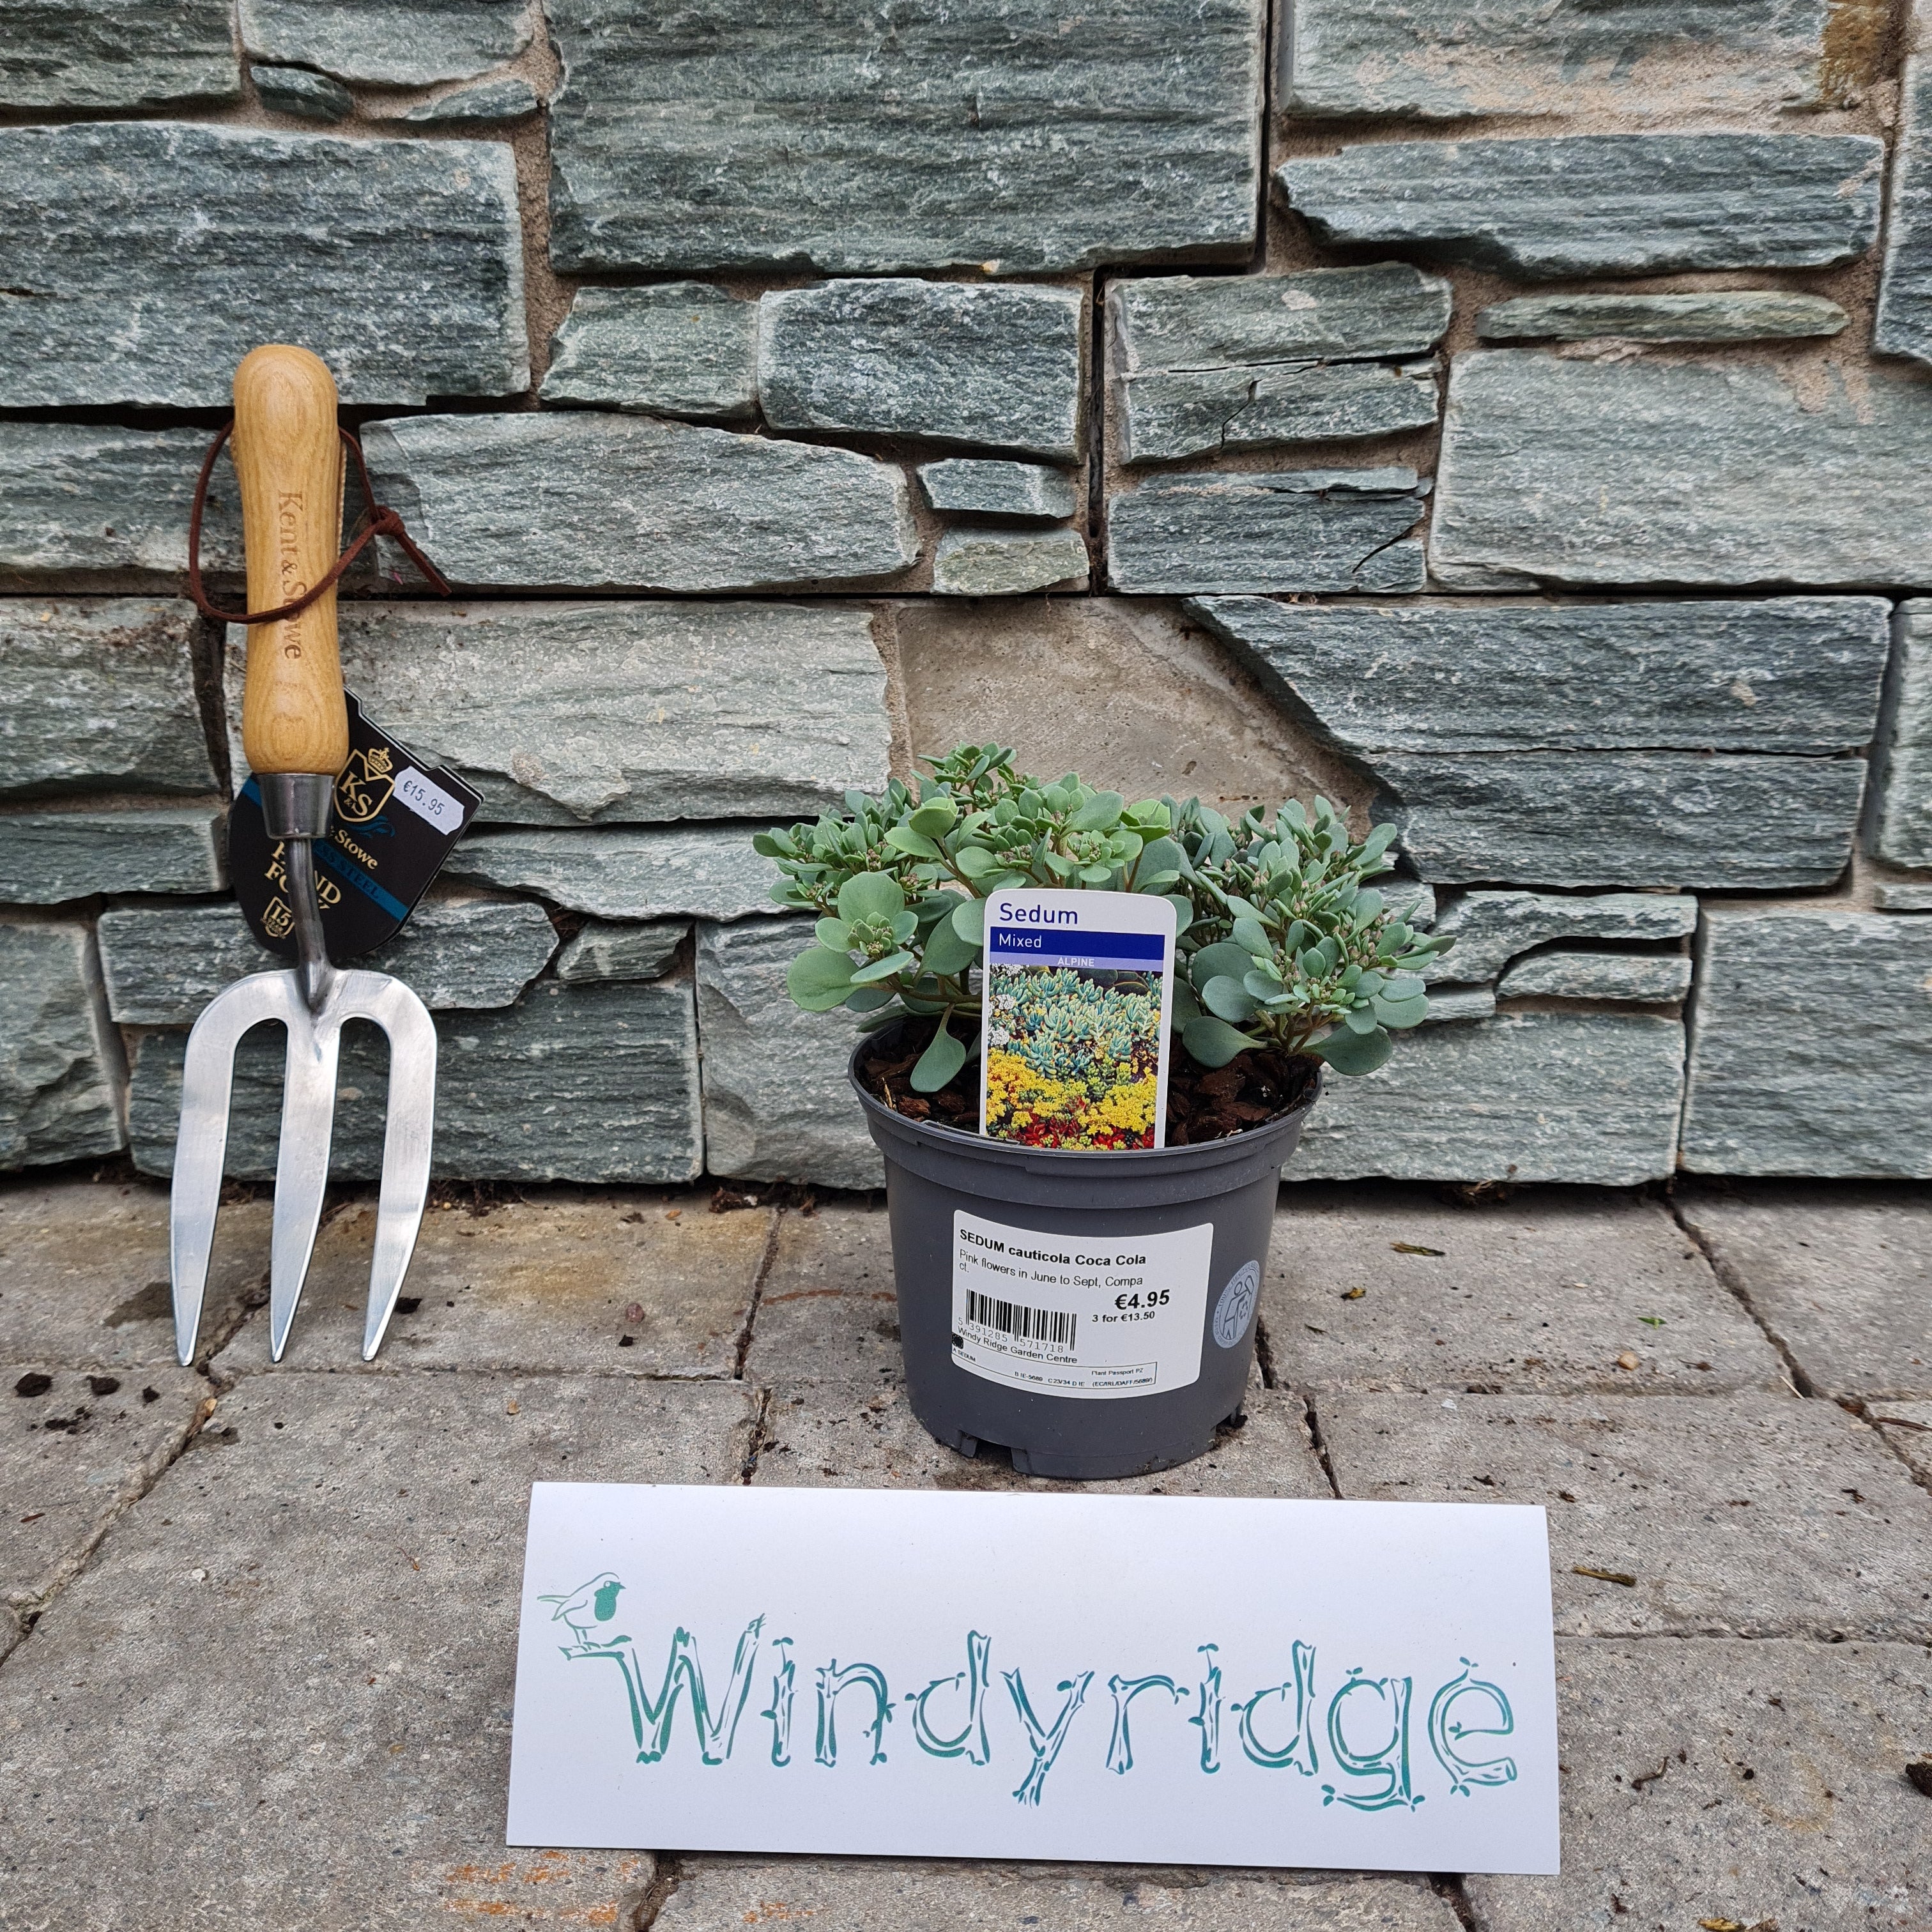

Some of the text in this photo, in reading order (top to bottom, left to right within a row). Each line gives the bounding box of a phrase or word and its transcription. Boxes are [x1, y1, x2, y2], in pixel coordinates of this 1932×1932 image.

[279, 489, 303, 555] Kent
[281, 560, 298, 575] &
[403, 780, 445, 816] €15.95
[334, 829, 378, 870] Stowe
[999, 902, 1078, 925] Sedum
[999, 933, 1042, 949] Mixed
[1057, 956, 1095, 967] ALPINE
[960, 1229, 1146, 1266] SEDUM cauticola Coca Cola
[960, 1248, 1143, 1289] Pink flowers in June to Sept, Compa
[1114, 1289, 1170, 1310] €4.95
[1091, 1310, 1155, 1322] 3 for €13.50
[958, 1325, 1078, 1363] Windy Ridge Garden Centre
[969, 1322, 1008, 1342] 391285
[1020, 1338, 1064, 1353] 571718
[958, 1349, 976, 1362] SEDUM
[607, 1614, 1518, 1812] Windyridge
